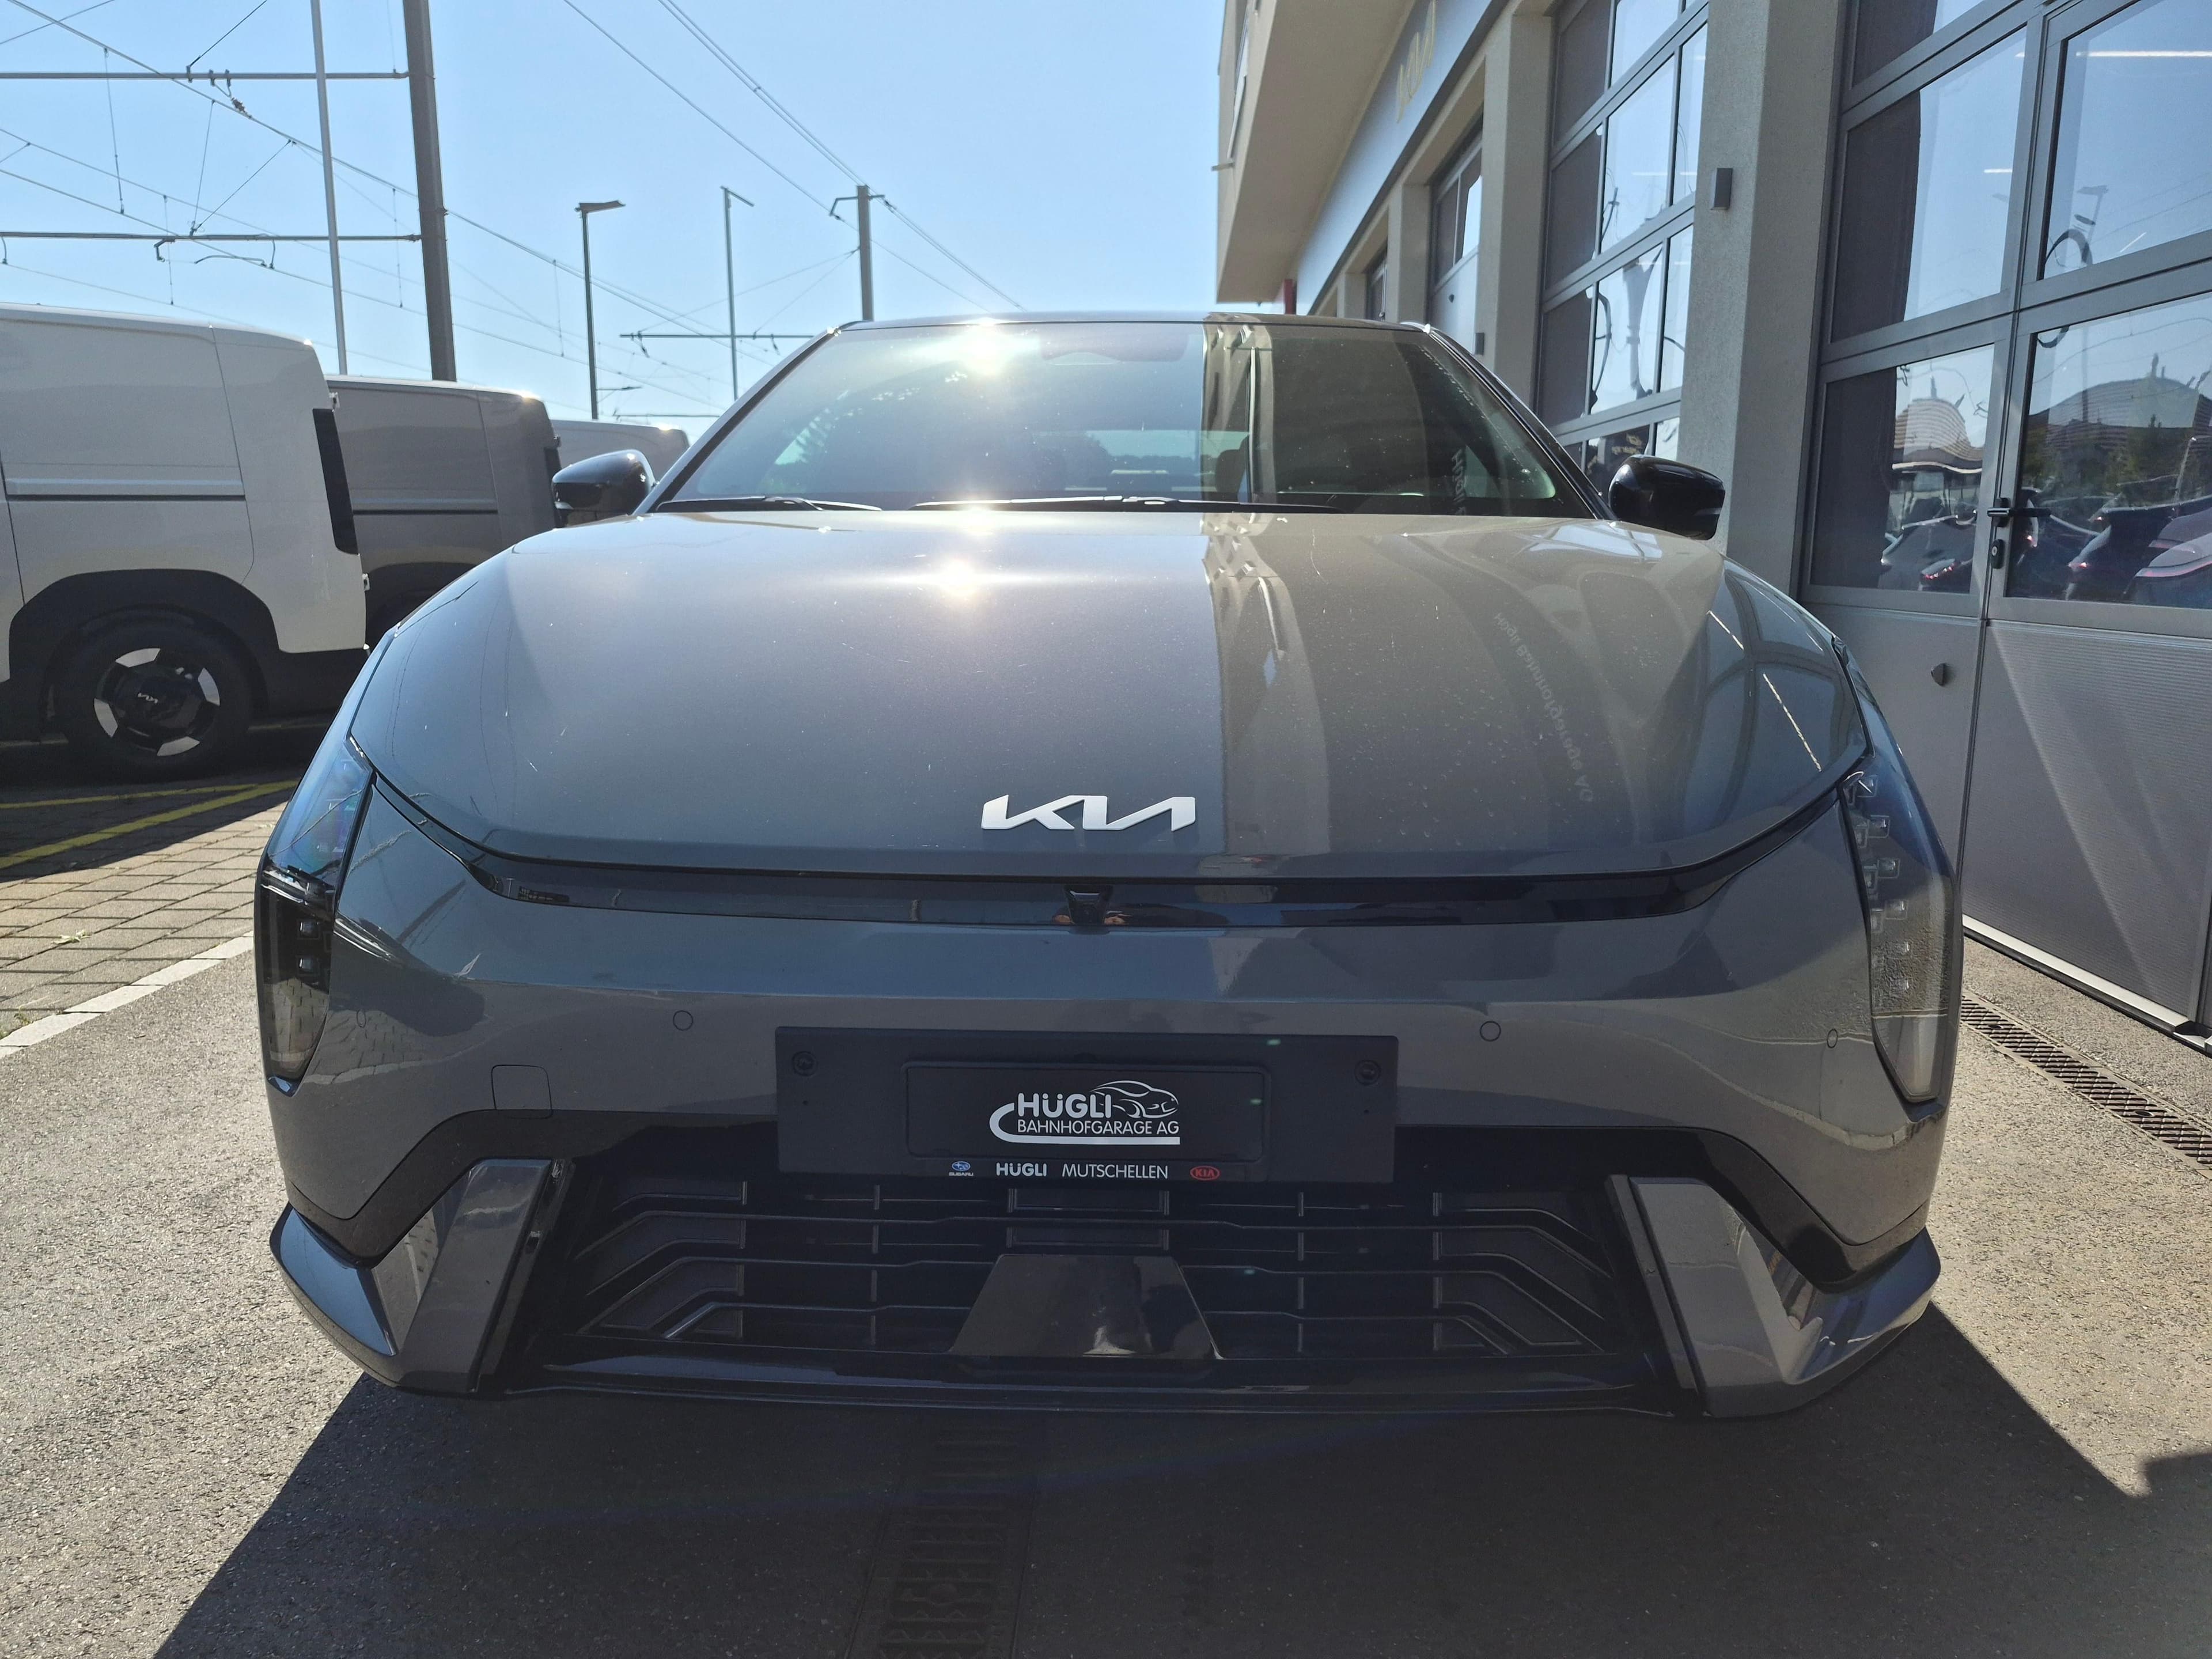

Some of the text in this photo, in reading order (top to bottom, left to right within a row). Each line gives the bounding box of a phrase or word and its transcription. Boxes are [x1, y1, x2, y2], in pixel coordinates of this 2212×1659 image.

[1017, 1119, 1180, 1134] BAHNHOFGARAGE AG
[1062, 1163, 1168, 1179] MUTSCHELLEN
